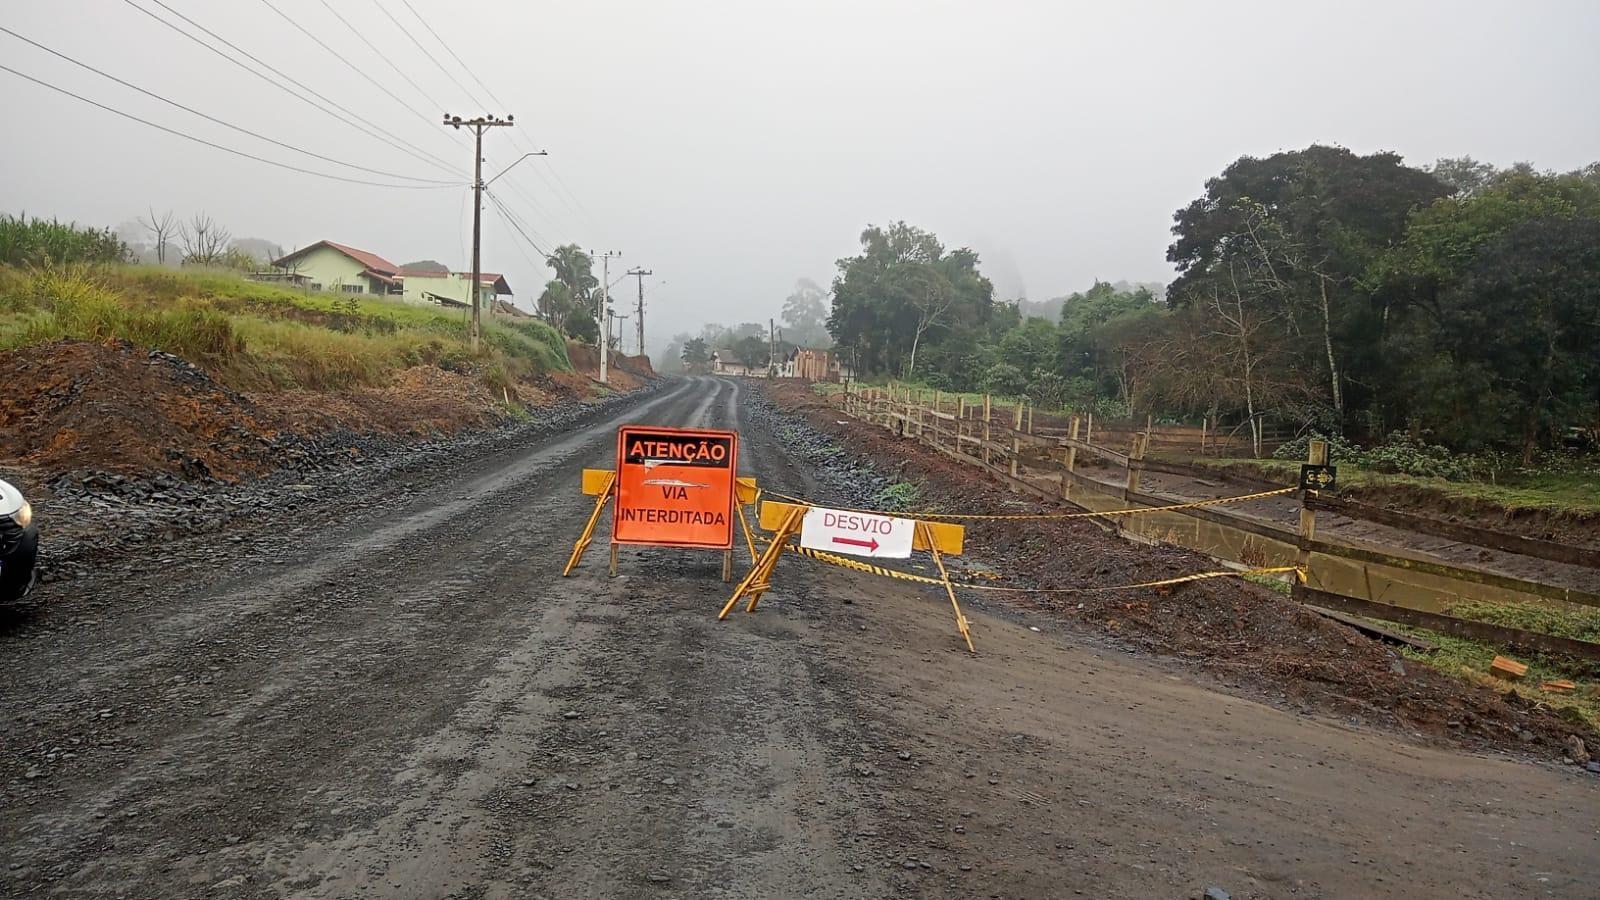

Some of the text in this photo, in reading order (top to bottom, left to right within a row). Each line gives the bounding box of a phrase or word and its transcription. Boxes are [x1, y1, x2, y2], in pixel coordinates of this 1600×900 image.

[630, 441, 725, 461] ATENÇÃO
[662, 486, 688, 500] VIA
[621, 508, 725, 525] INTERDITADA
[823, 513, 892, 535] DESVIO
